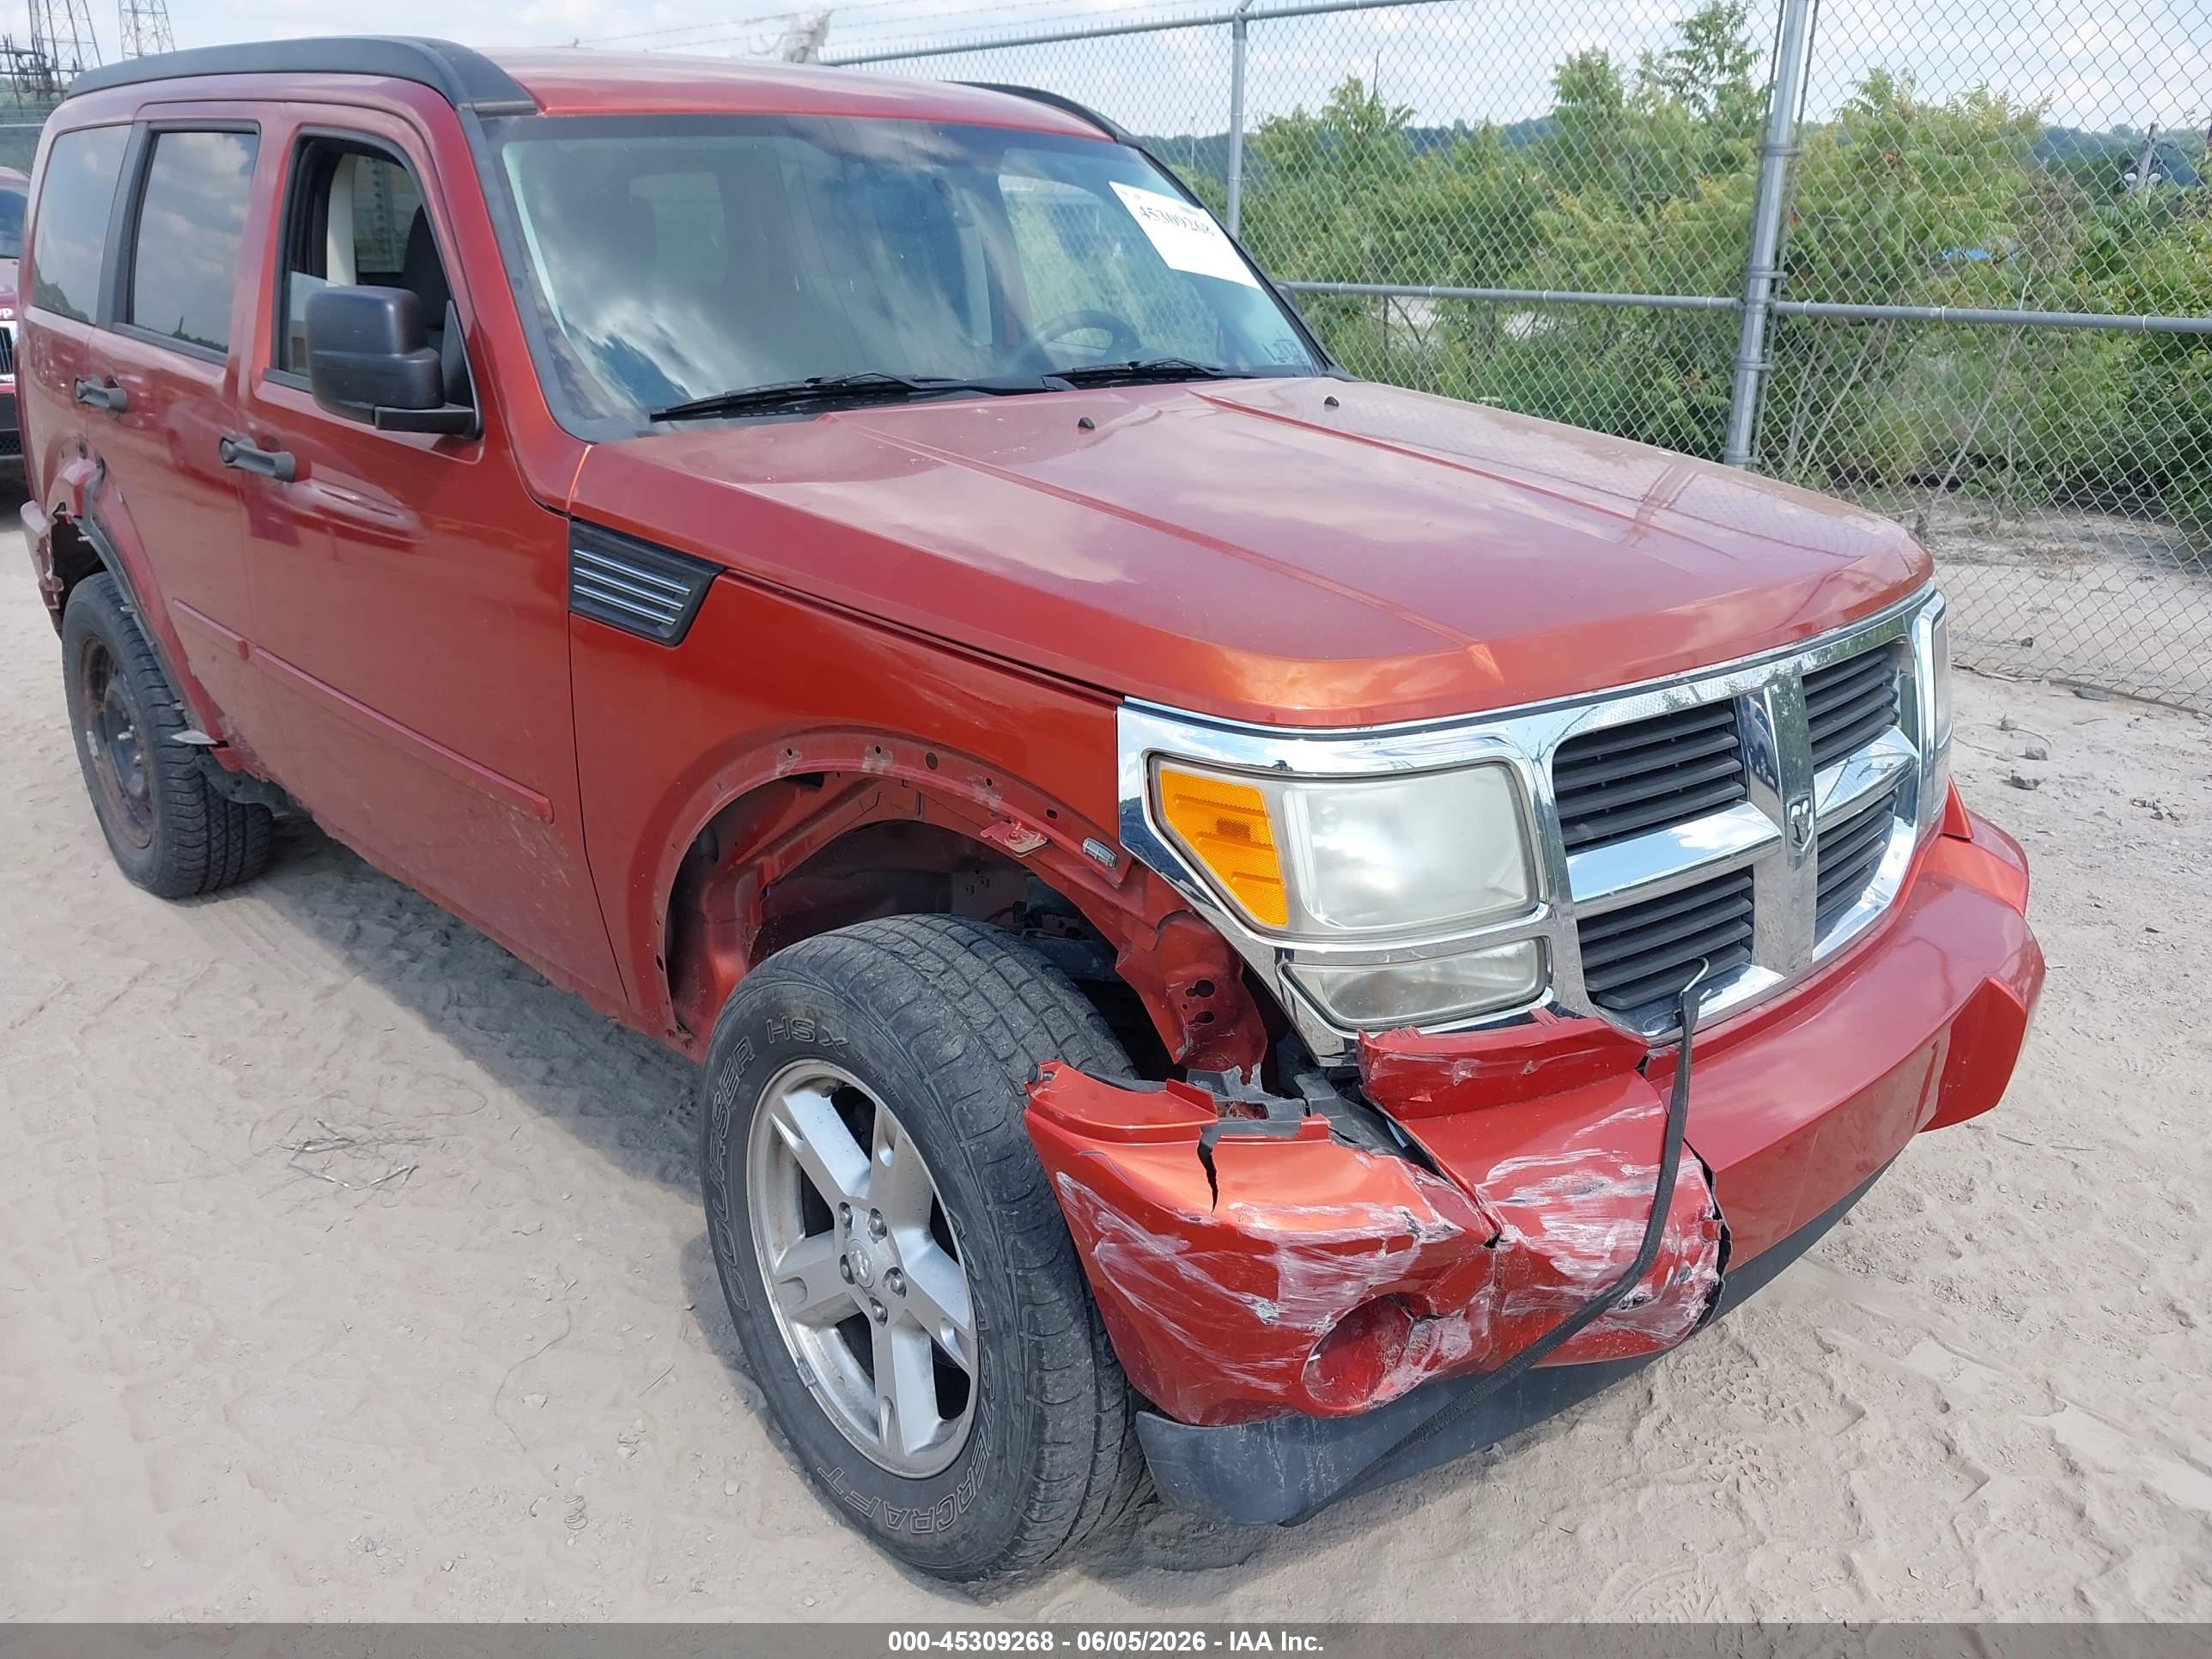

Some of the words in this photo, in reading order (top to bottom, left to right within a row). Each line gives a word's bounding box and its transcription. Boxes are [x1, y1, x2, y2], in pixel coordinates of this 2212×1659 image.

[709, 1036, 756, 1312] COURSER
[765, 1015, 849, 1059] HSX
[817, 1205, 996, 1534] MASTERCRAFT
